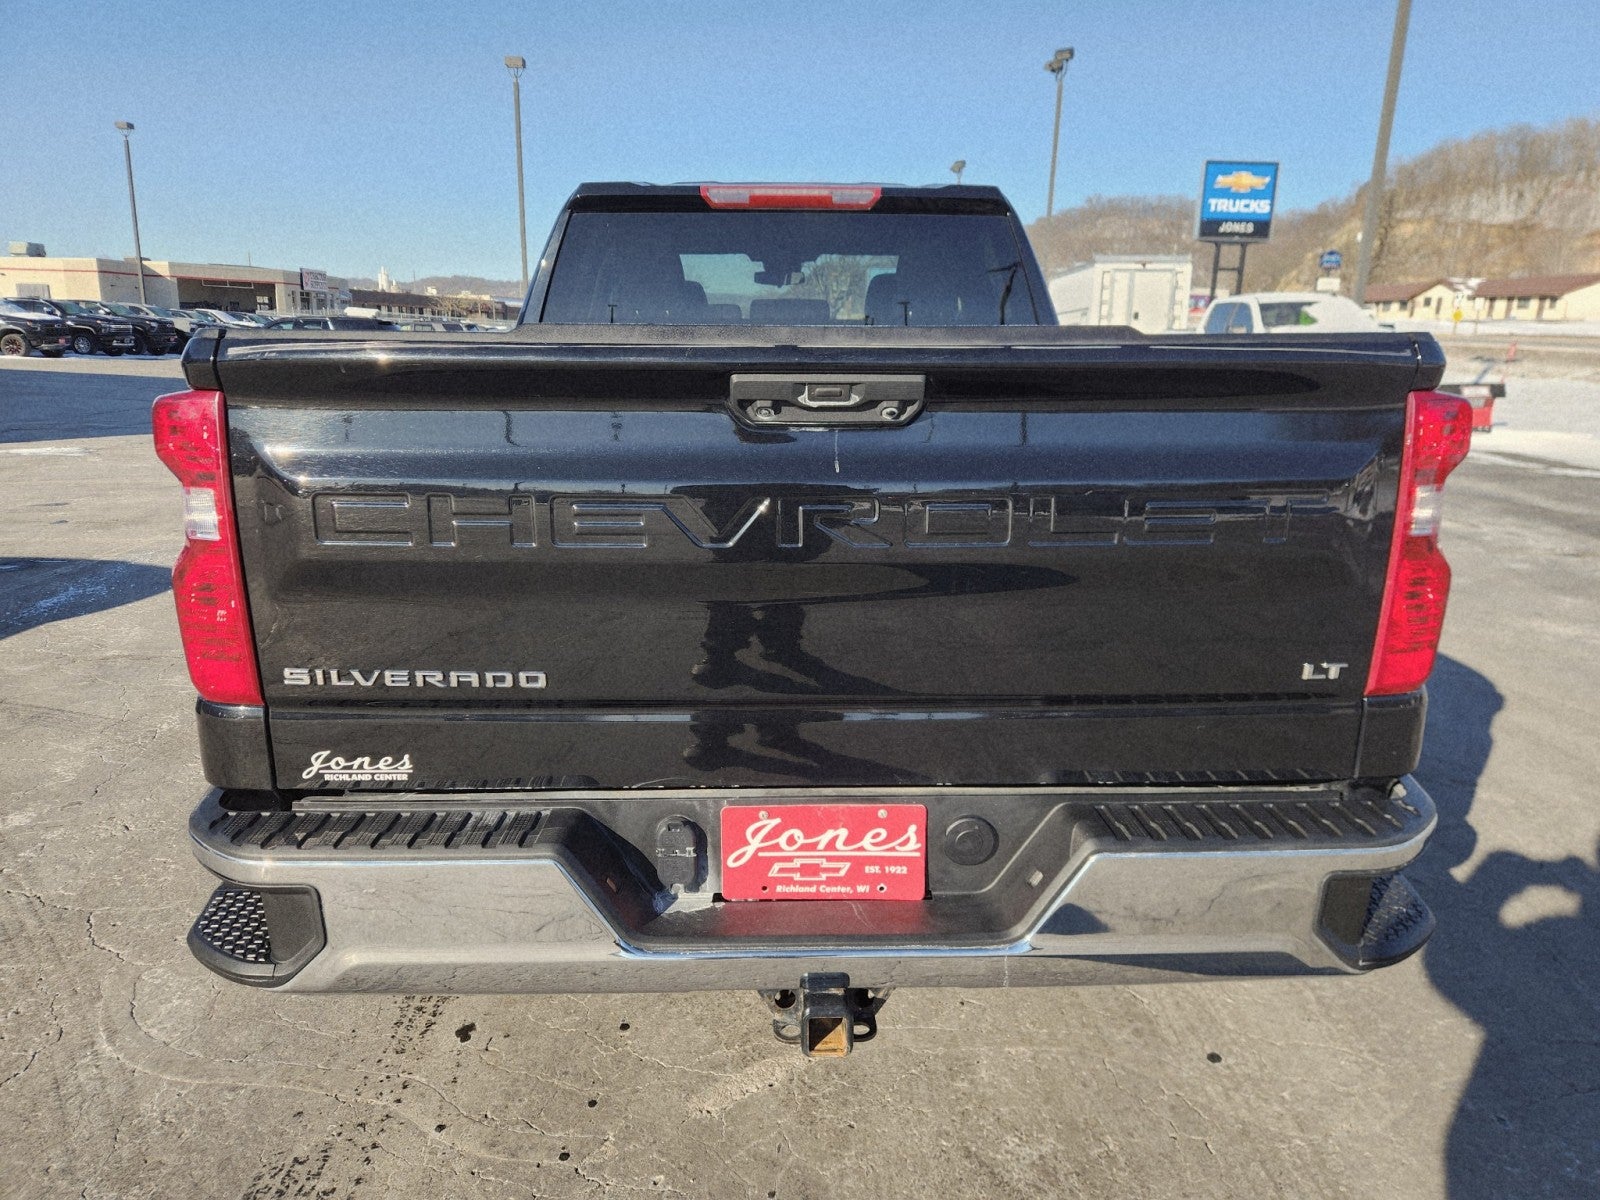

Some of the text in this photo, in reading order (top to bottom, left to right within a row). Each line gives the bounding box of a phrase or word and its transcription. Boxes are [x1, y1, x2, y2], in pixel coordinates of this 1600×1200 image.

[1208, 198, 1272, 214] TRUCKS
[1218, 221, 1255, 234] JONES
[310, 489, 1330, 549] CHEVROLET
[282, 667, 548, 690] SILVERADO
[1301, 662, 1349, 680] LT
[301, 750, 414, 780] Jones
[323, 772, 409, 782] RICHLAND CENTER
[726, 817, 922, 868] Jones
[864, 865, 908, 875] EST. 1922
[775, 884, 870, 895] Richland Center, WI
